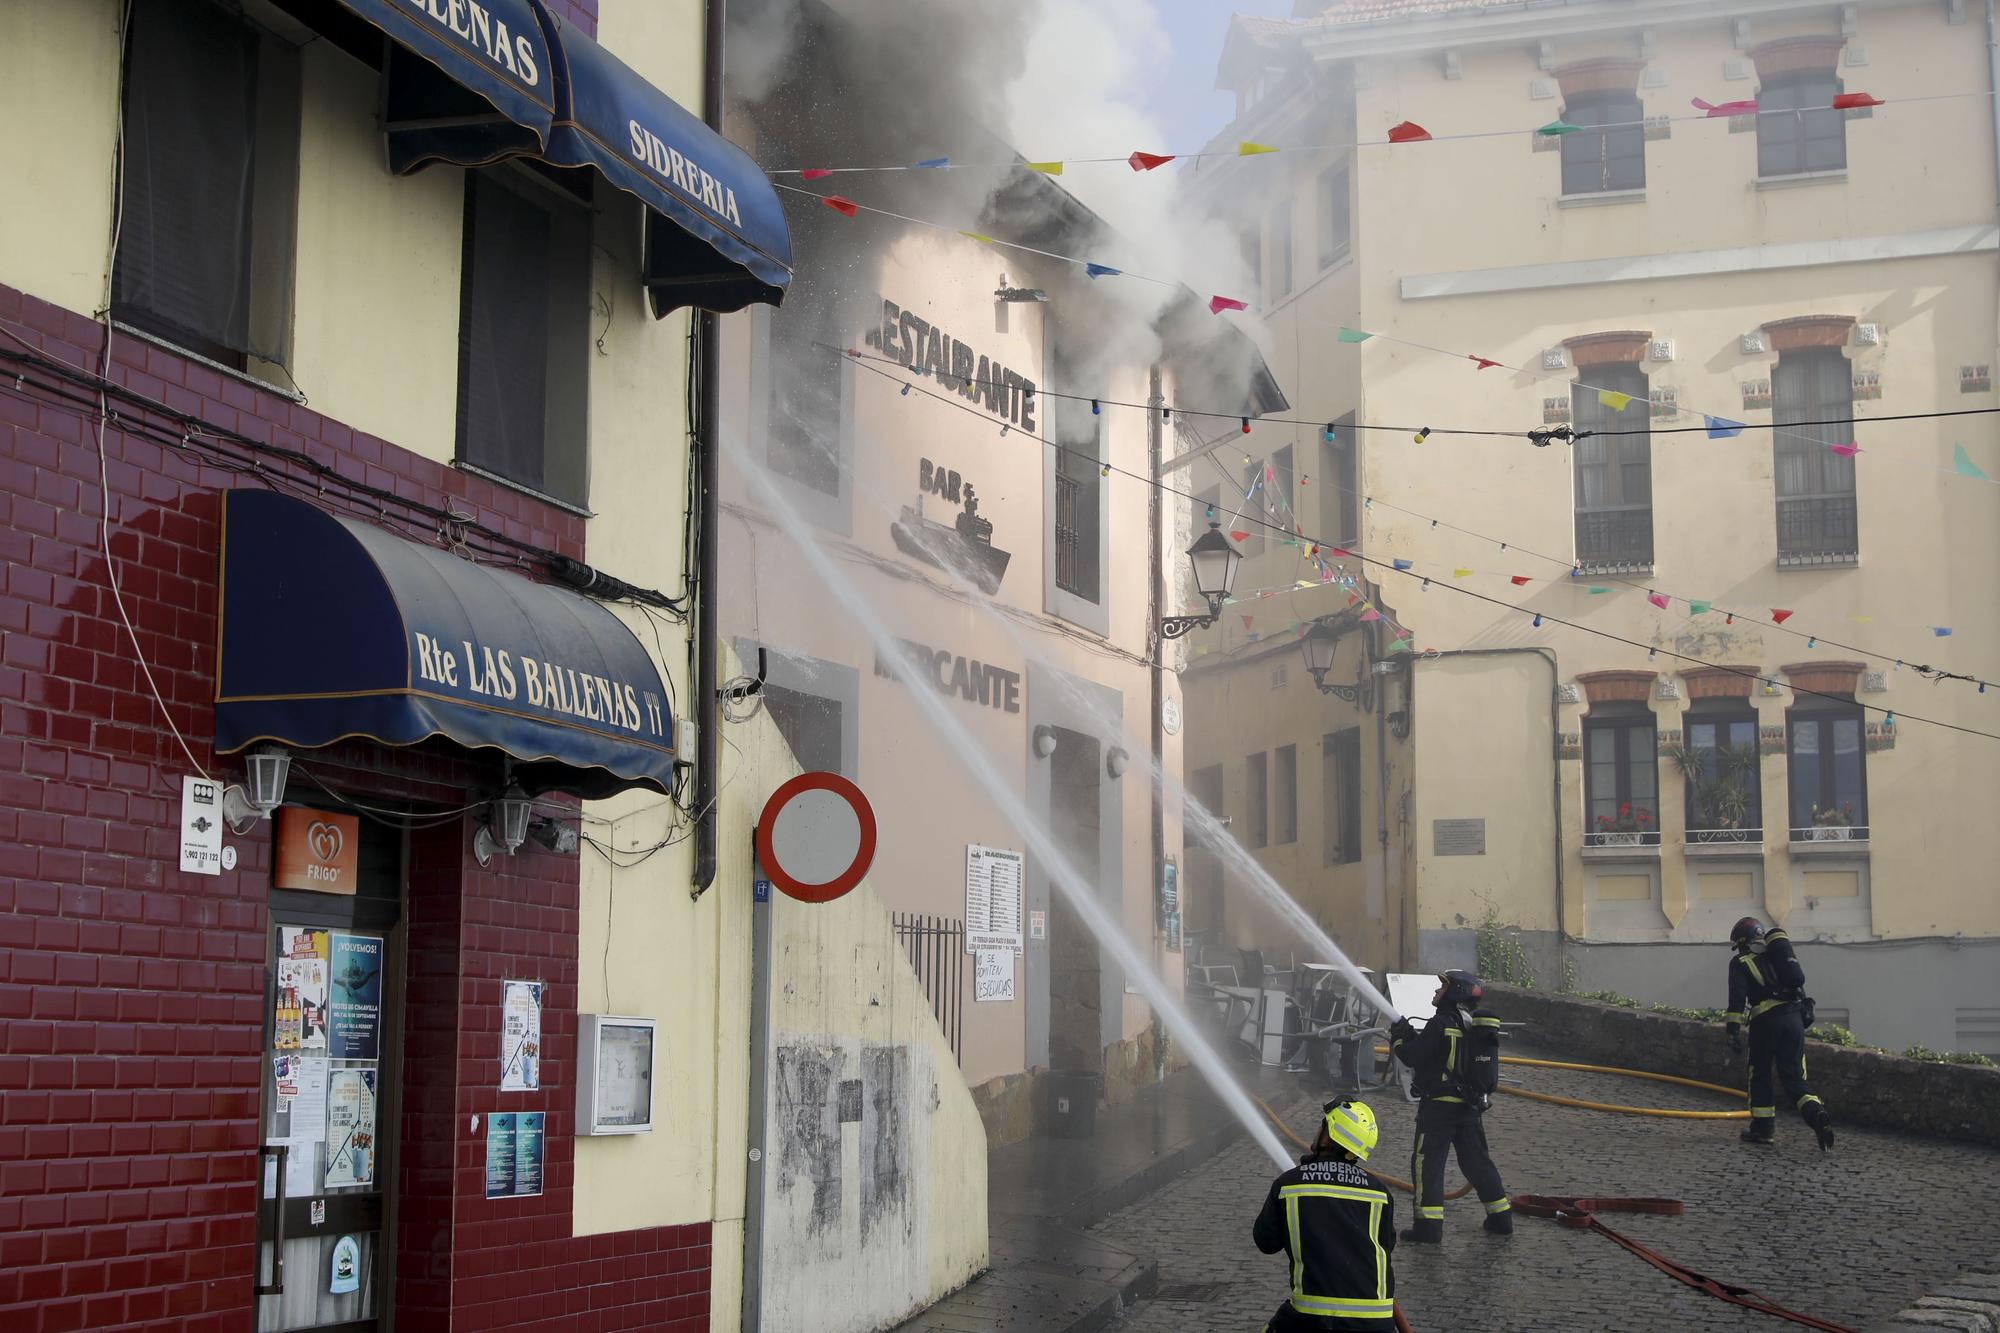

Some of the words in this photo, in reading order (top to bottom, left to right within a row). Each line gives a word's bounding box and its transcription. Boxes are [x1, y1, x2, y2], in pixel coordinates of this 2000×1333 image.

[629, 120, 742, 228] SIDRERIA
[920, 457, 961, 504] BAR
[415, 632, 457, 687] Rte
[462, 641, 516, 699] LAS
[521, 656, 640, 731] BALLENAS
[874, 637, 1020, 713] RCANTE
[189, 850, 198, 859] 902
[199, 851, 208, 860] 121
[209, 852, 218, 861] 122
[307, 864, 338, 881] FRIGO
[337, 943, 377, 954] ¡VOLVEMOS!
[1302, 1172, 1334, 1181] AYTO.
